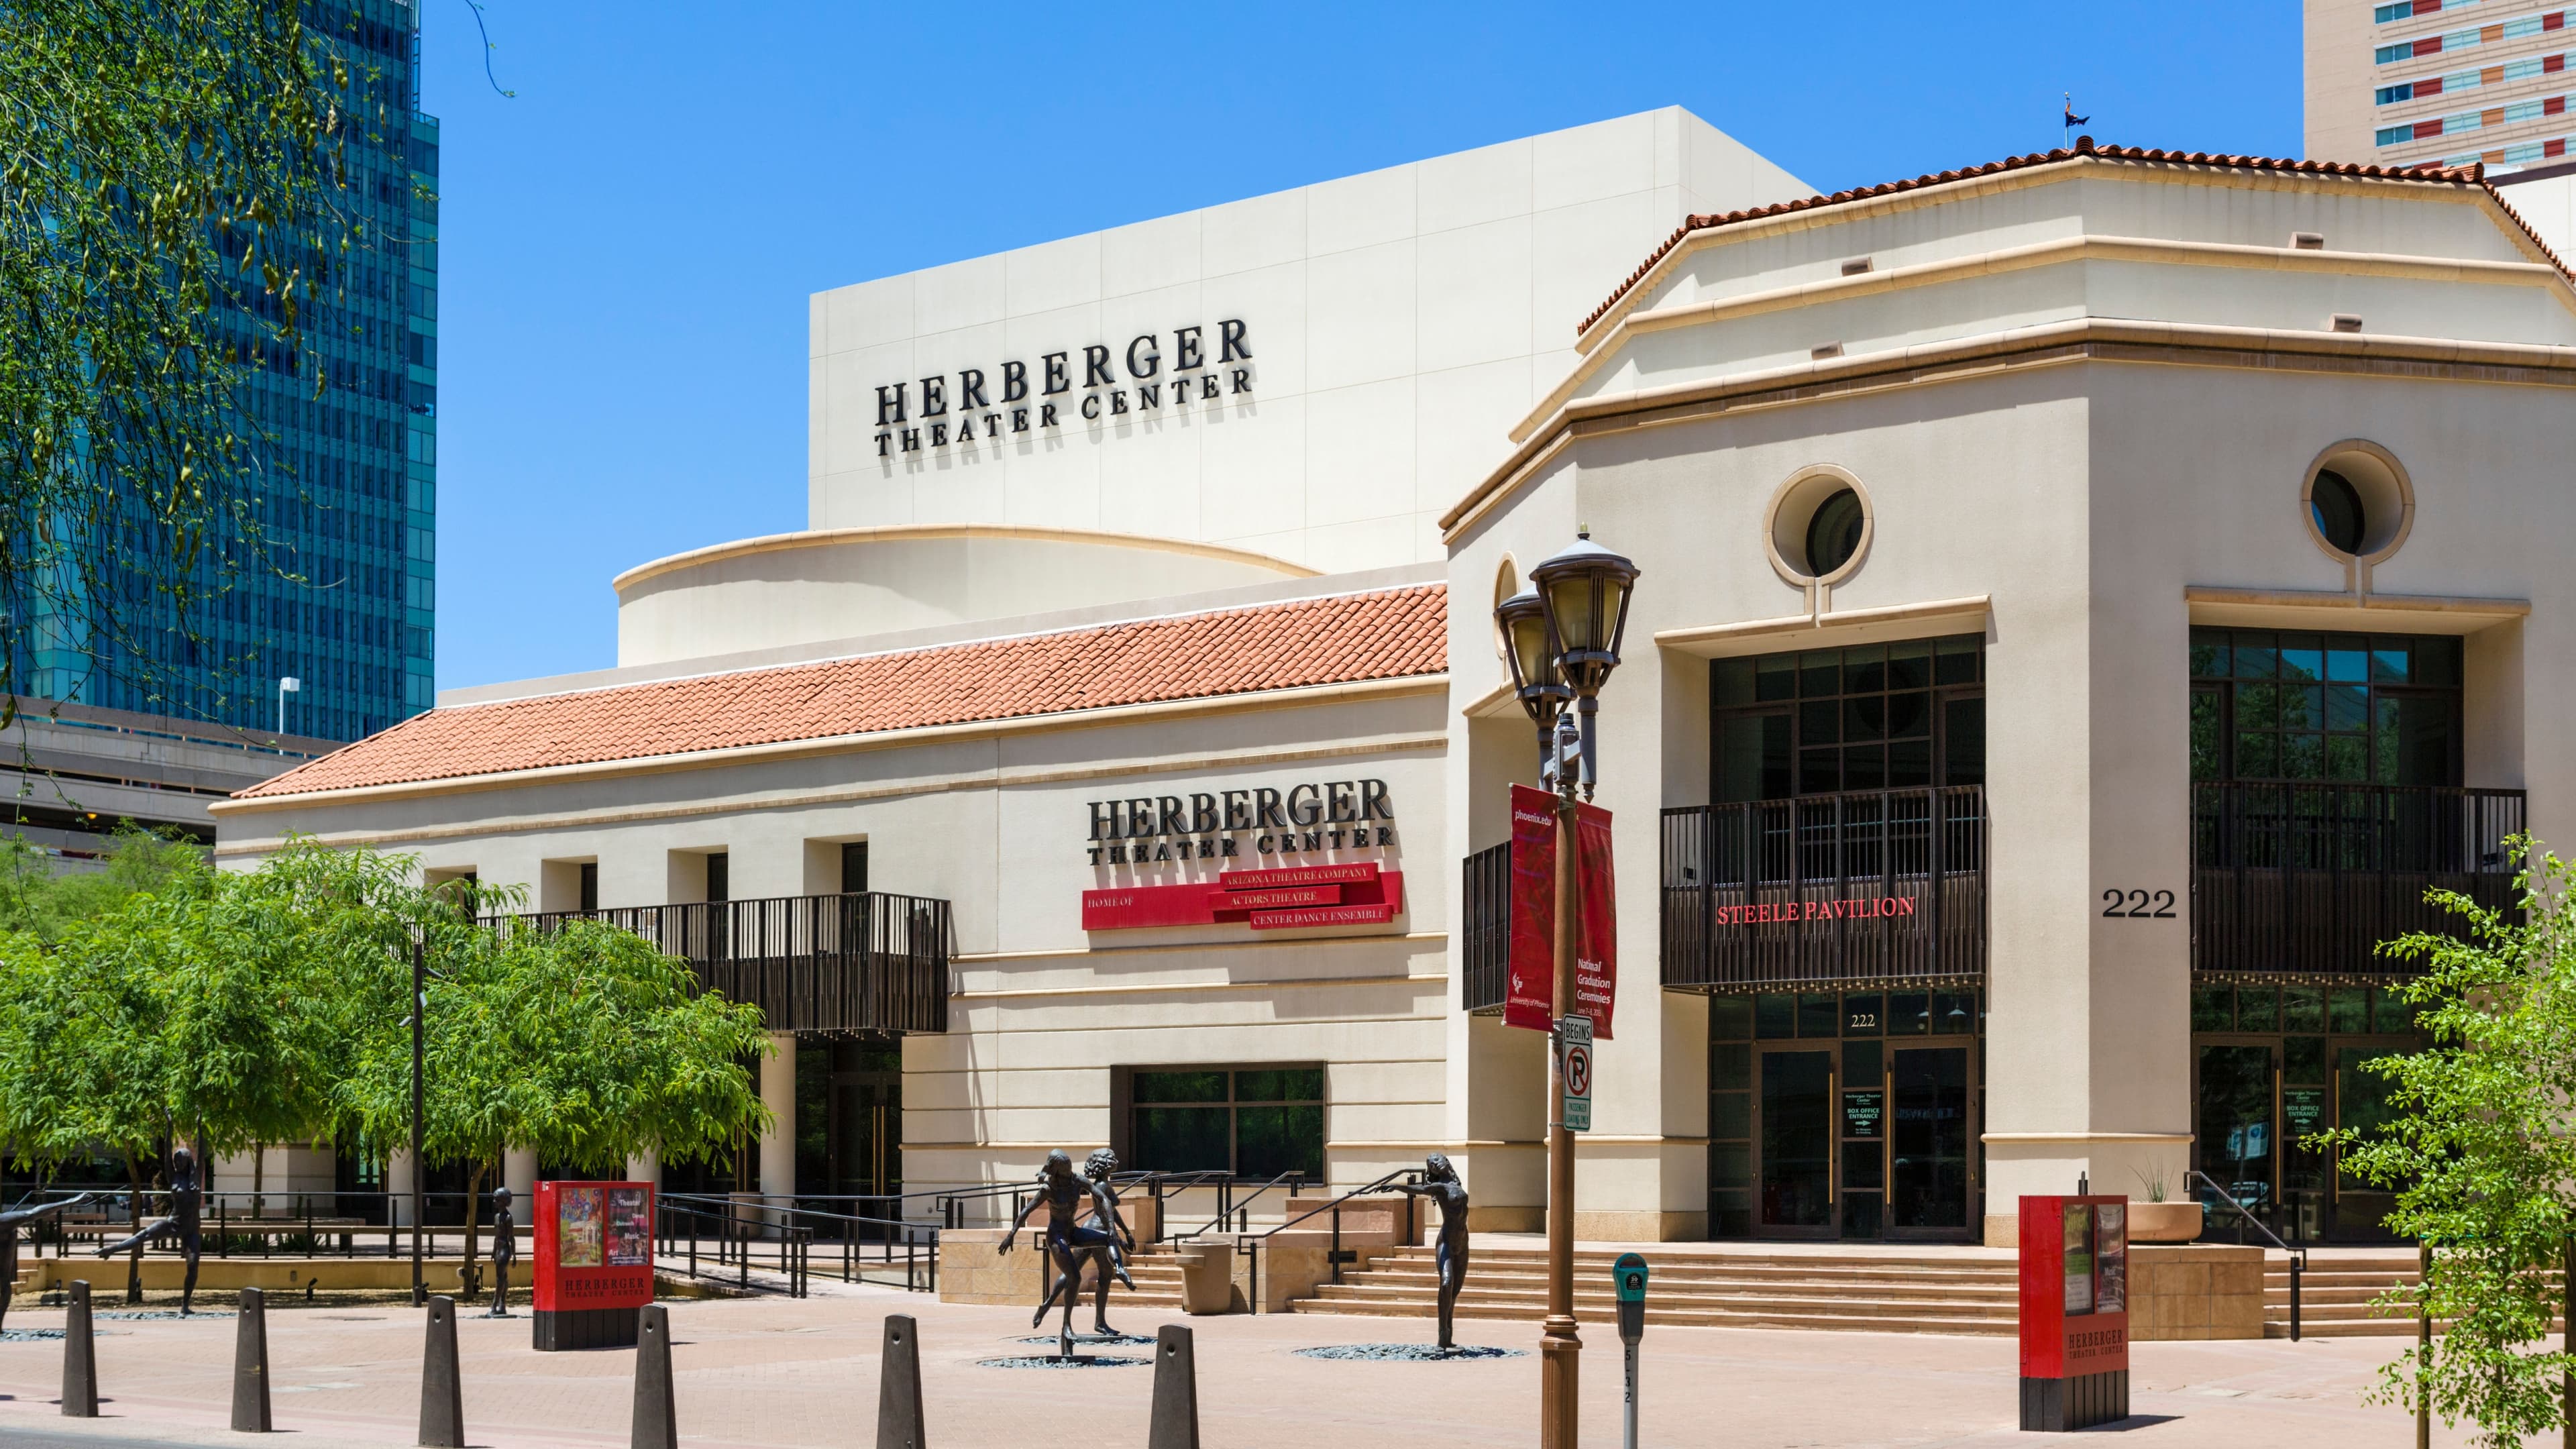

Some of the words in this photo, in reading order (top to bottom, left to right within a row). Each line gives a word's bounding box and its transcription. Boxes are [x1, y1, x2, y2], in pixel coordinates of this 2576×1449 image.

[874, 319, 1253, 426] HERBERGER
[874, 404, 1059, 457] THEATER
[1081, 369, 1252, 420] CENTER
[1087, 778, 1394, 842] HERBERGER
[1515, 809, 1552, 826] phoenix.edu
[1087, 838, 1238, 866] THEATER
[1257, 826, 1395, 855] CENTER
[1226, 875, 1269, 885] ARIZONA
[1271, 871, 1317, 883] THEATRE
[1318, 867, 1368, 880] COMPANY
[1087, 898, 1118, 908] HOME
[1120, 897, 1134, 906] OF
[1231, 895, 1269, 906] ACTORS
[1271, 891, 1318, 904] THEATRE
[2102, 889, 2176, 918] 222
[1253, 914, 1292, 925] CENTER
[1295, 912, 1328, 923] DANCE
[1330, 908, 1385, 922] ENSEMBLE
[1717, 902, 1799, 924] STEELE
[1804, 897, 1915, 920] PAVILION
[1511, 996, 1529, 1008] University
[1577, 1007, 1585, 1015] June
[1851, 1014, 1875, 1028] 222
[1566, 1022, 1590, 1040] BEGINS
[1568, 1102, 1587, 1112] PASSENGER
[620, 1199, 641, 1207] Theater
[625, 1232, 640, 1240] Music
[565, 1278, 645, 1291] HERBERGER
[565, 1291, 604, 1299] THEATER
[612, 1289, 645, 1297] CENTER
[2069, 1329, 2123, 1349] HERBERGER
[2069, 1348, 2096, 1360] THEATER
[2100, 1344, 2123, 1356] CENTER
